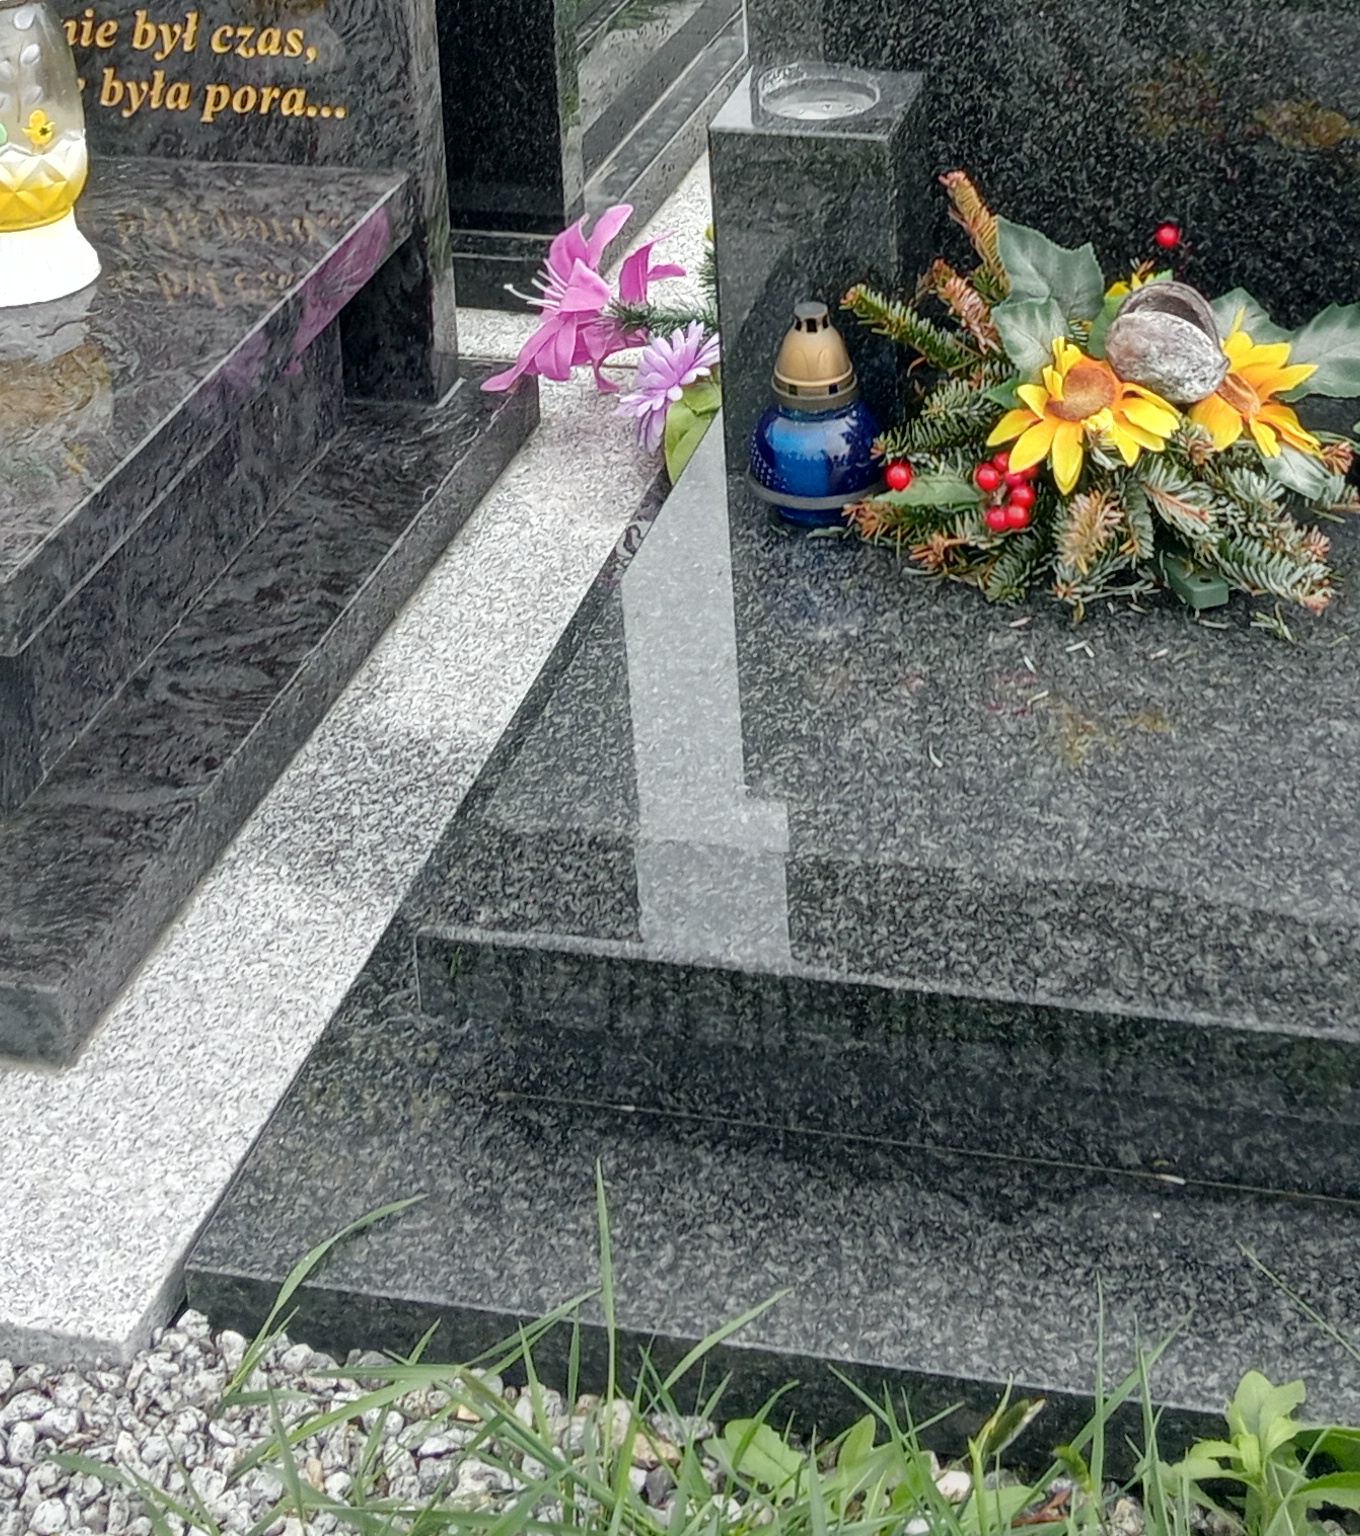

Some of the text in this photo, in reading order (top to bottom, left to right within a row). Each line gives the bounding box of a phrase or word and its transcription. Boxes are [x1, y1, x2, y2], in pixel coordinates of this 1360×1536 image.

[131, 9, 201, 61] był
[210, 24, 320, 64] czas,
[99, 66, 348, 124] była pora...
